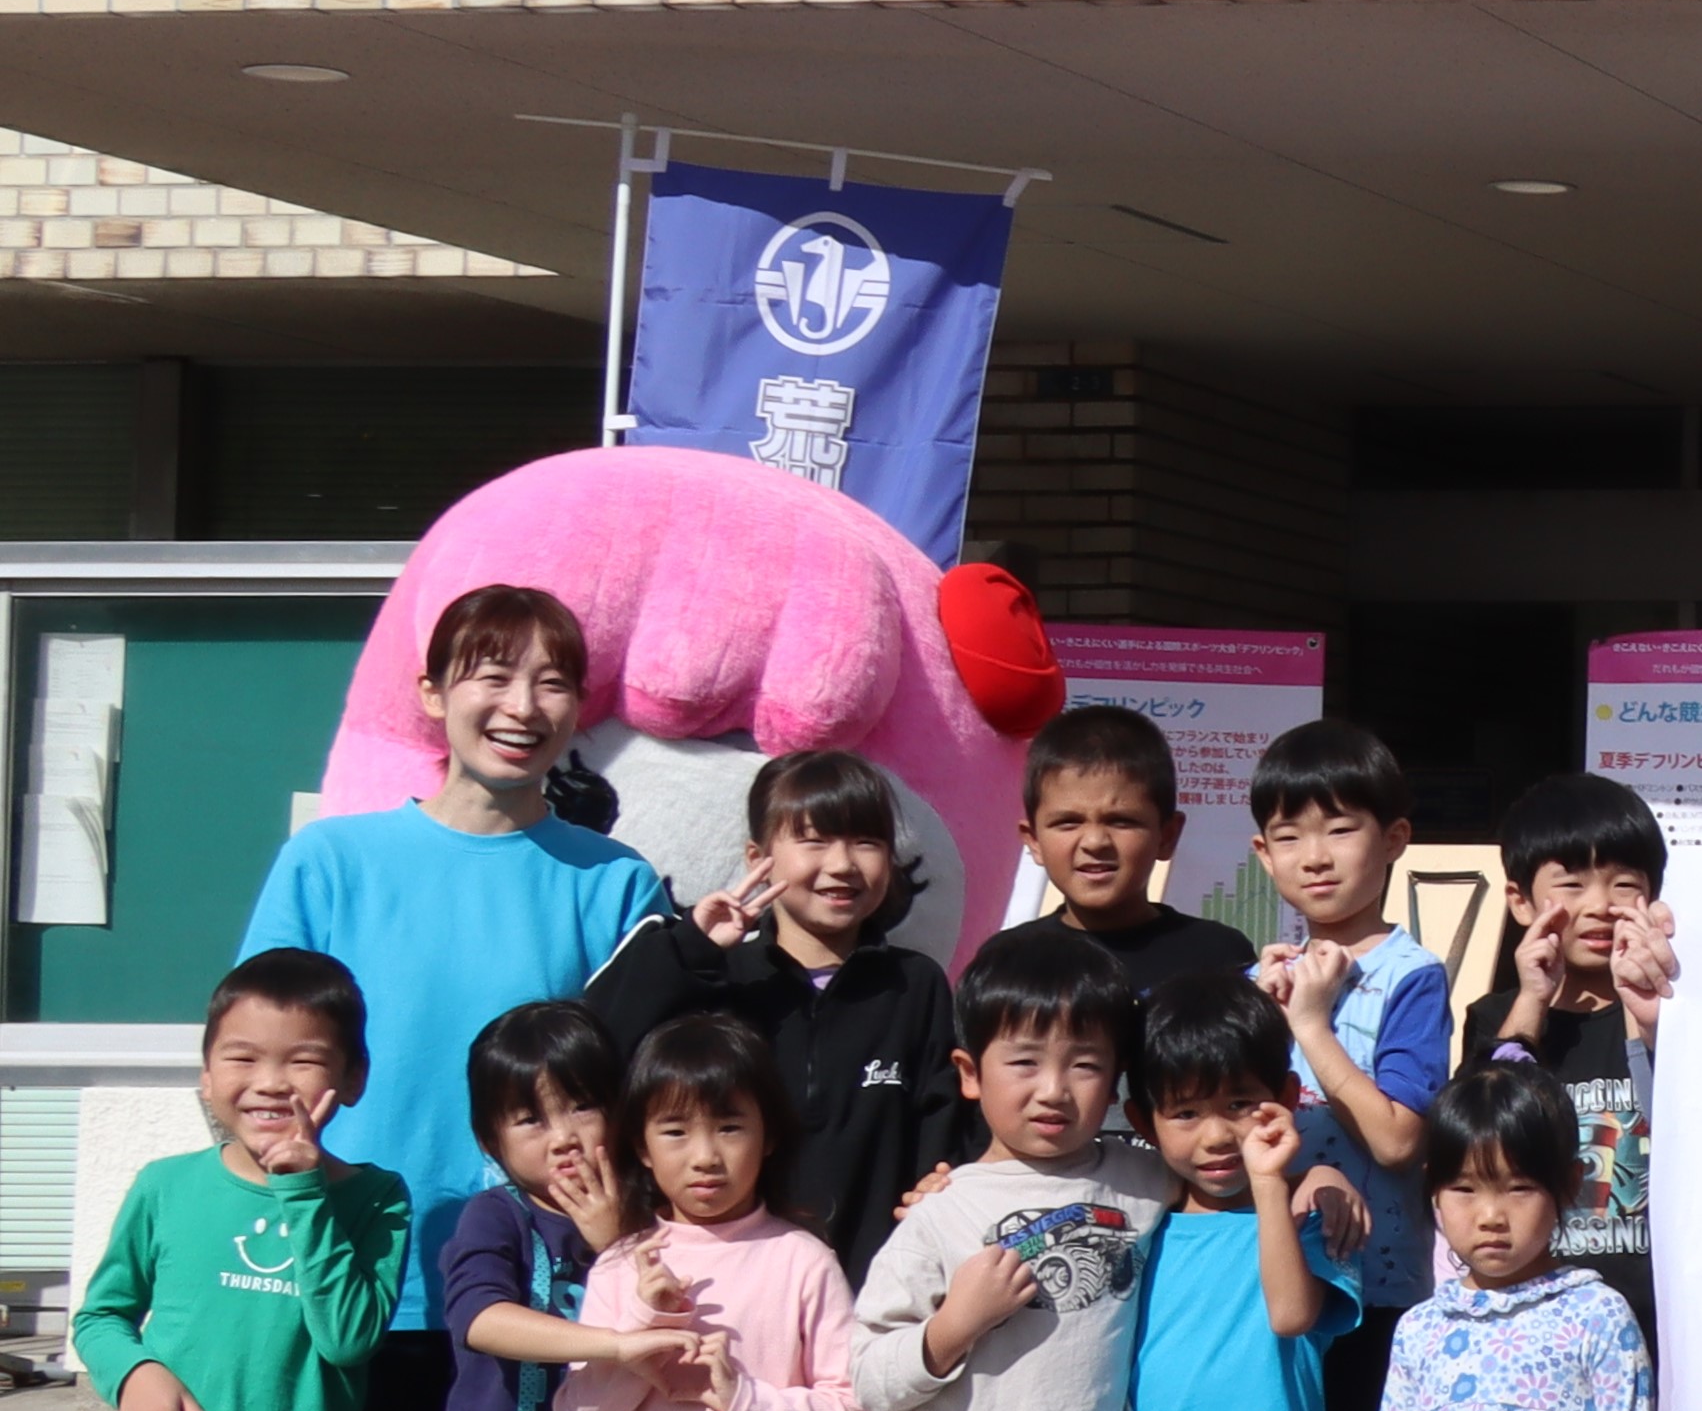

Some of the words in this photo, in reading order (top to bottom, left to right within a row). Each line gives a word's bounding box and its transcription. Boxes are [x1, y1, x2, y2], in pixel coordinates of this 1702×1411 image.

[749, 375, 855, 491] 荒
[862, 1059, 903, 1088] Luck
[1030, 1204, 1087, 1236] VEGAS
